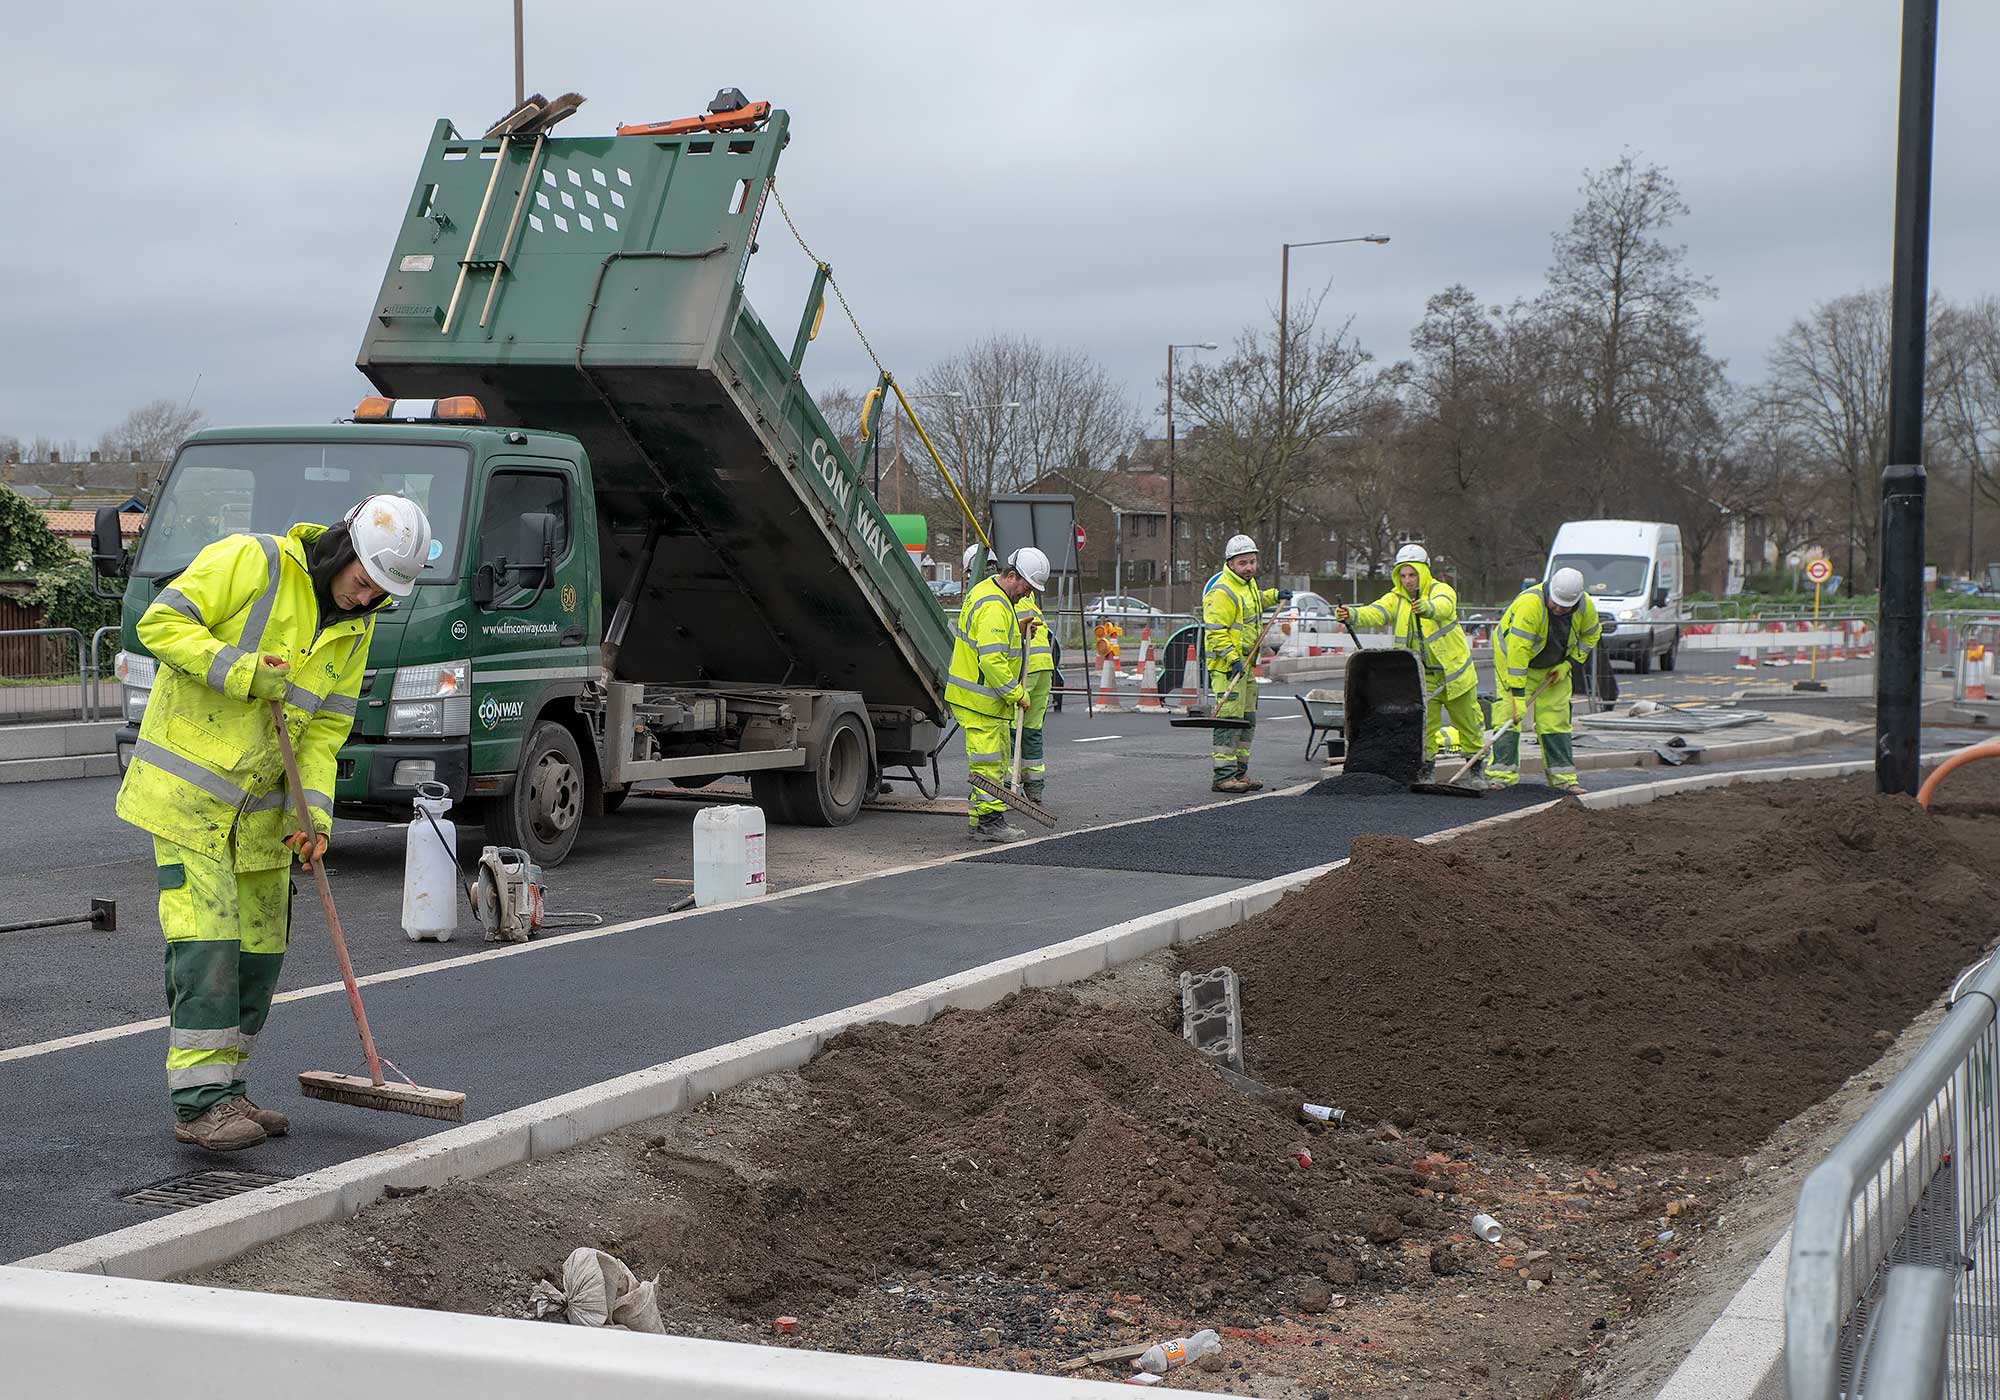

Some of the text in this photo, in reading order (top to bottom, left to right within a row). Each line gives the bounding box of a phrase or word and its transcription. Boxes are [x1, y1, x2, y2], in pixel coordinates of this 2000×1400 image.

[563, 587, 574, 604] 50
[481, 621, 558, 636] www.fmconway.co.uk
[478, 701, 524, 719] CONWAY
